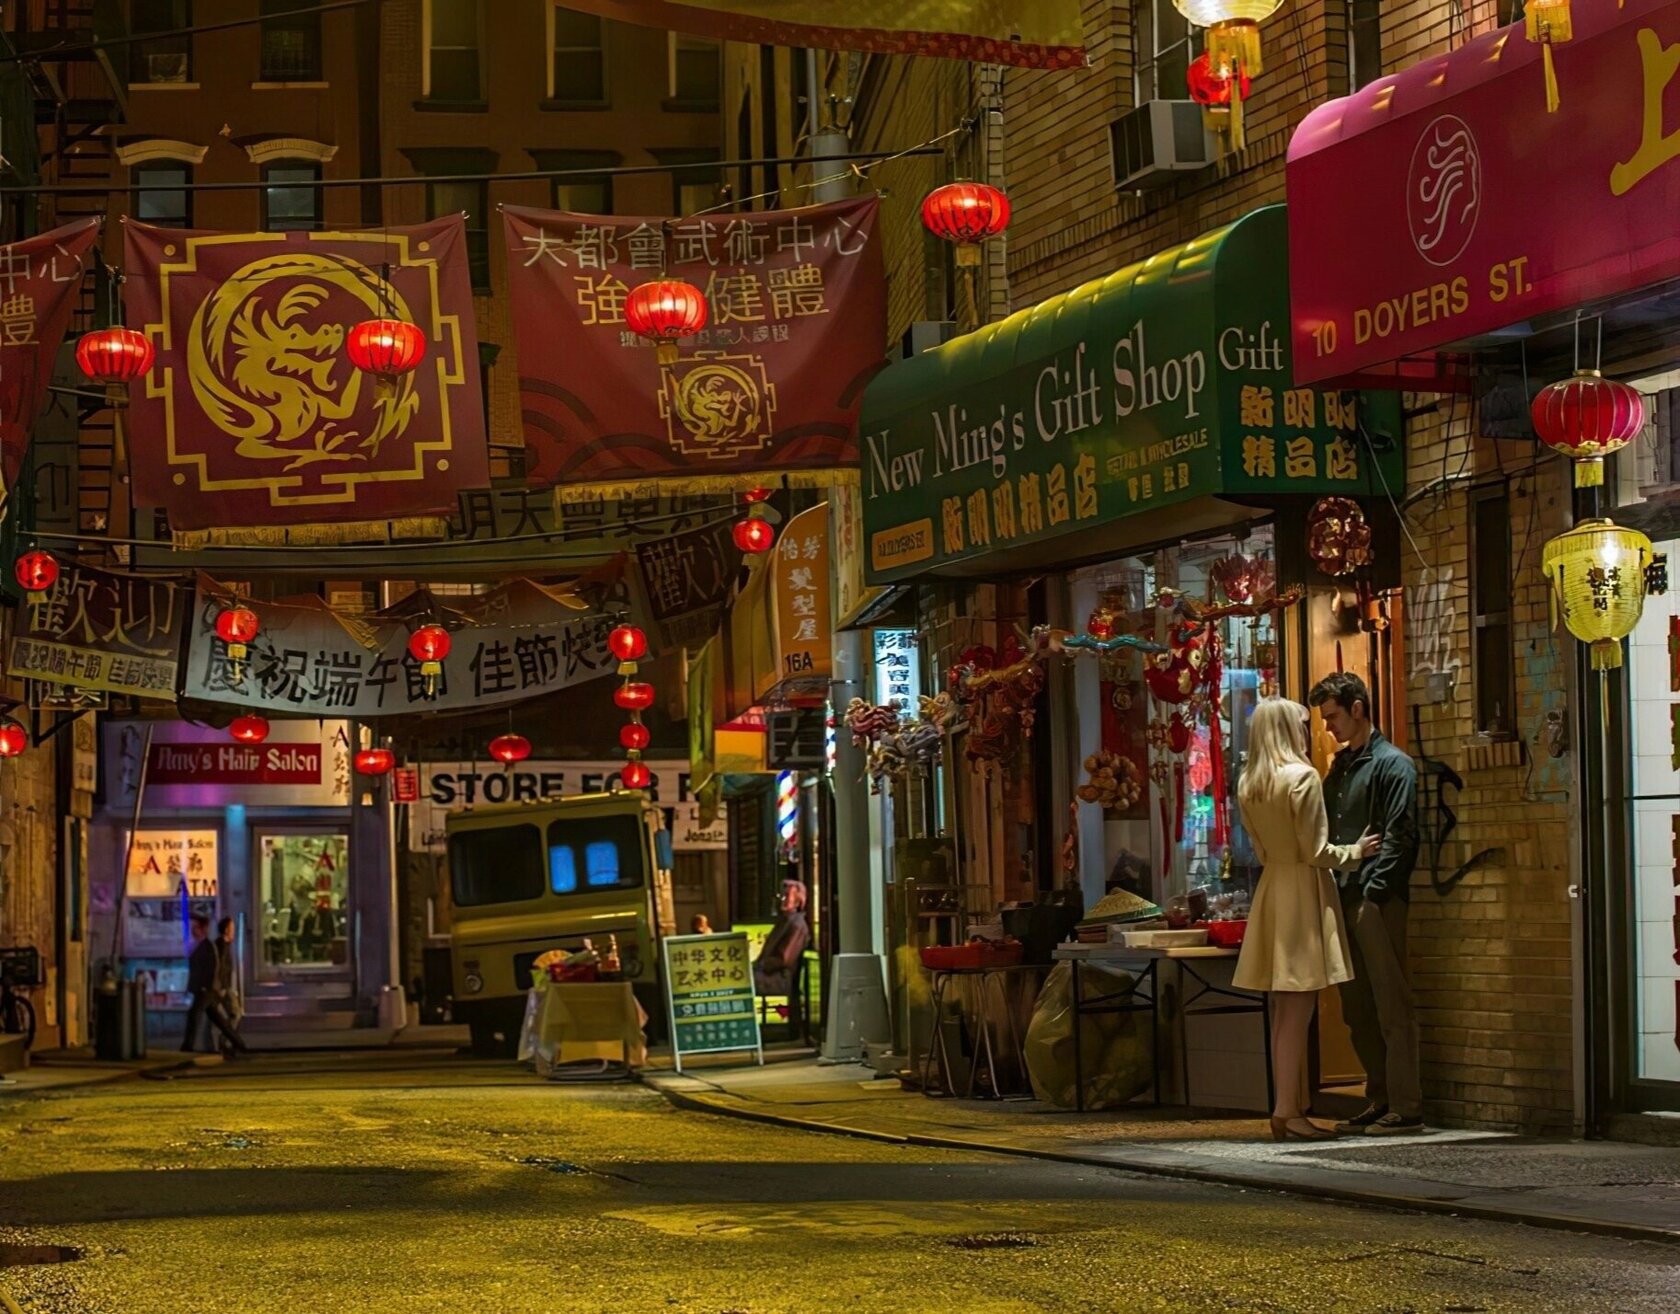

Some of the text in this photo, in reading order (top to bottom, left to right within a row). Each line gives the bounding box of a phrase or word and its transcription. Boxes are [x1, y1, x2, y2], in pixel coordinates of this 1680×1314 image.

[522, 214, 867, 269] 大都會武術中心
[573, 263, 829, 325] 強健體
[1312, 256, 1533, 357] 10 DOYERS ST.
[1219, 320, 1285, 371] Gift
[866, 318, 1206, 500] New Ming's Gift Shop
[785, 651, 814, 673] 16A
[218, 747, 260, 772] Hair
[266, 748, 318, 772] Salon
[431, 772, 564, 804] STORE
